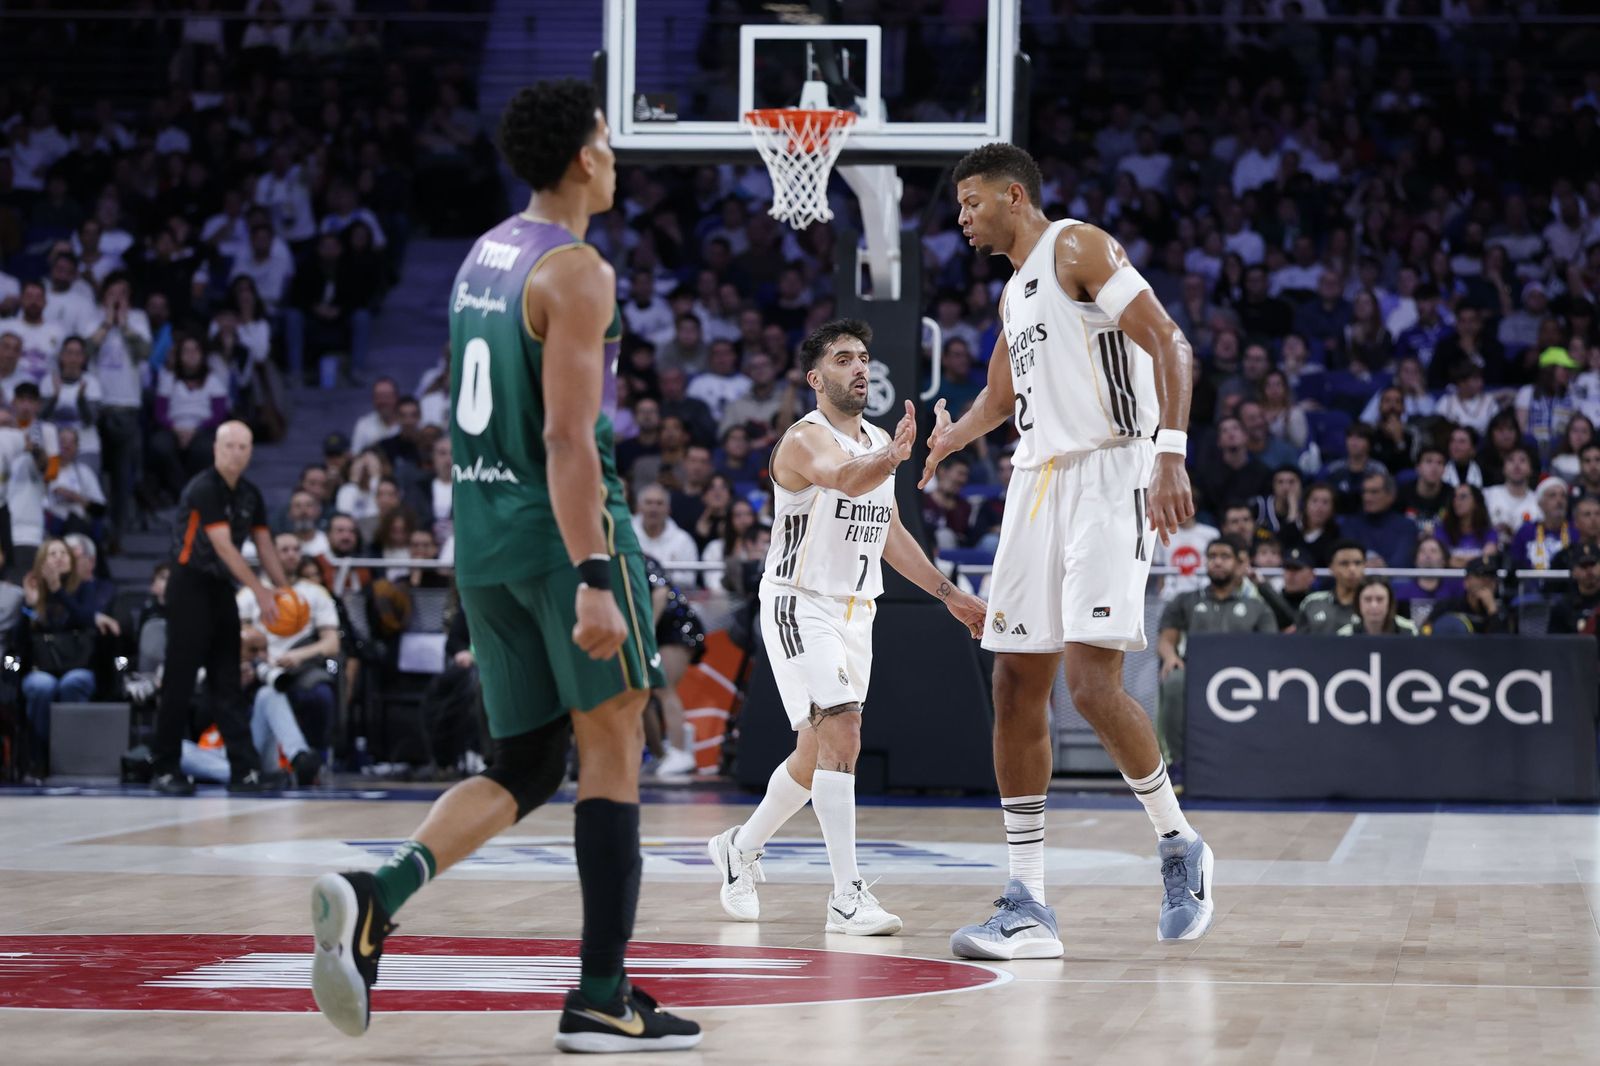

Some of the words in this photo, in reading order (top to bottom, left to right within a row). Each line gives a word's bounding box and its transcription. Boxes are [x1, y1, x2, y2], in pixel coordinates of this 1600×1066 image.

[456, 336, 493, 436] 0
[855, 554, 869, 592] 7
[1206, 652, 1553, 725] endesa
